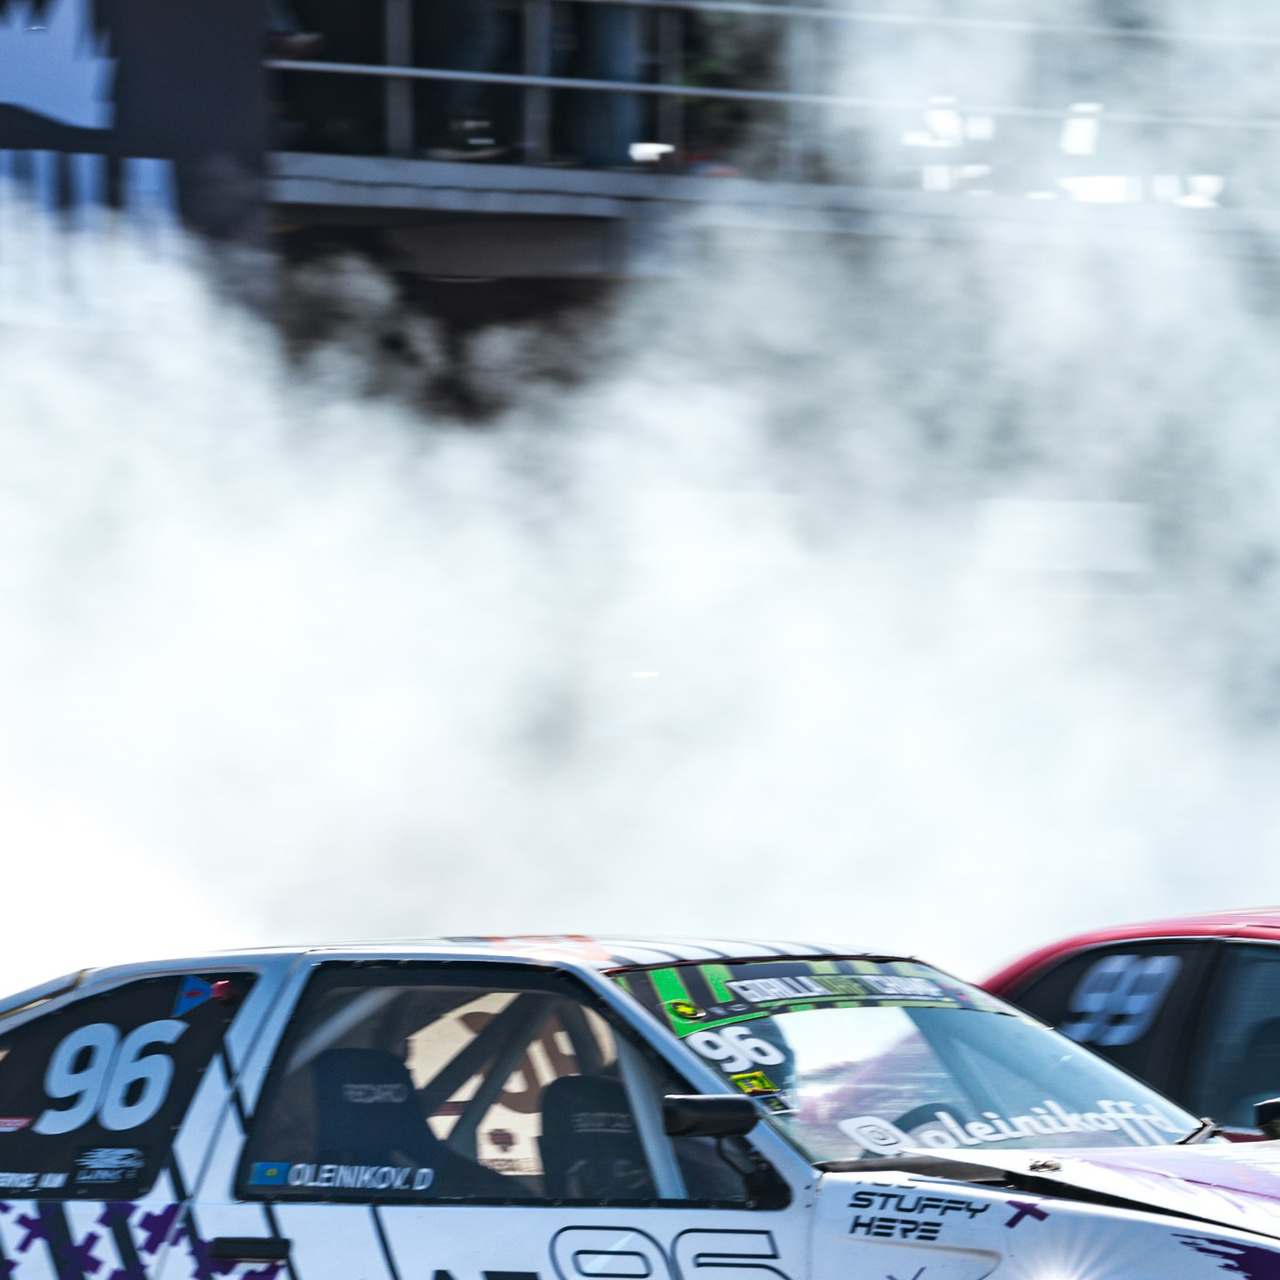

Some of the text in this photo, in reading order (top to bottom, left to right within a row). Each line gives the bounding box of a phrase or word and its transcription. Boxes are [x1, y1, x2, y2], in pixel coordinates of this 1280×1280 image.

[685, 1026, 786, 1073] 96
[30, 1019, 191, 1135] 96
[412, 1167, 435, 1191] D
[847, 1190, 992, 1219] STUFFY
[849, 1215, 944, 1241] HERE
